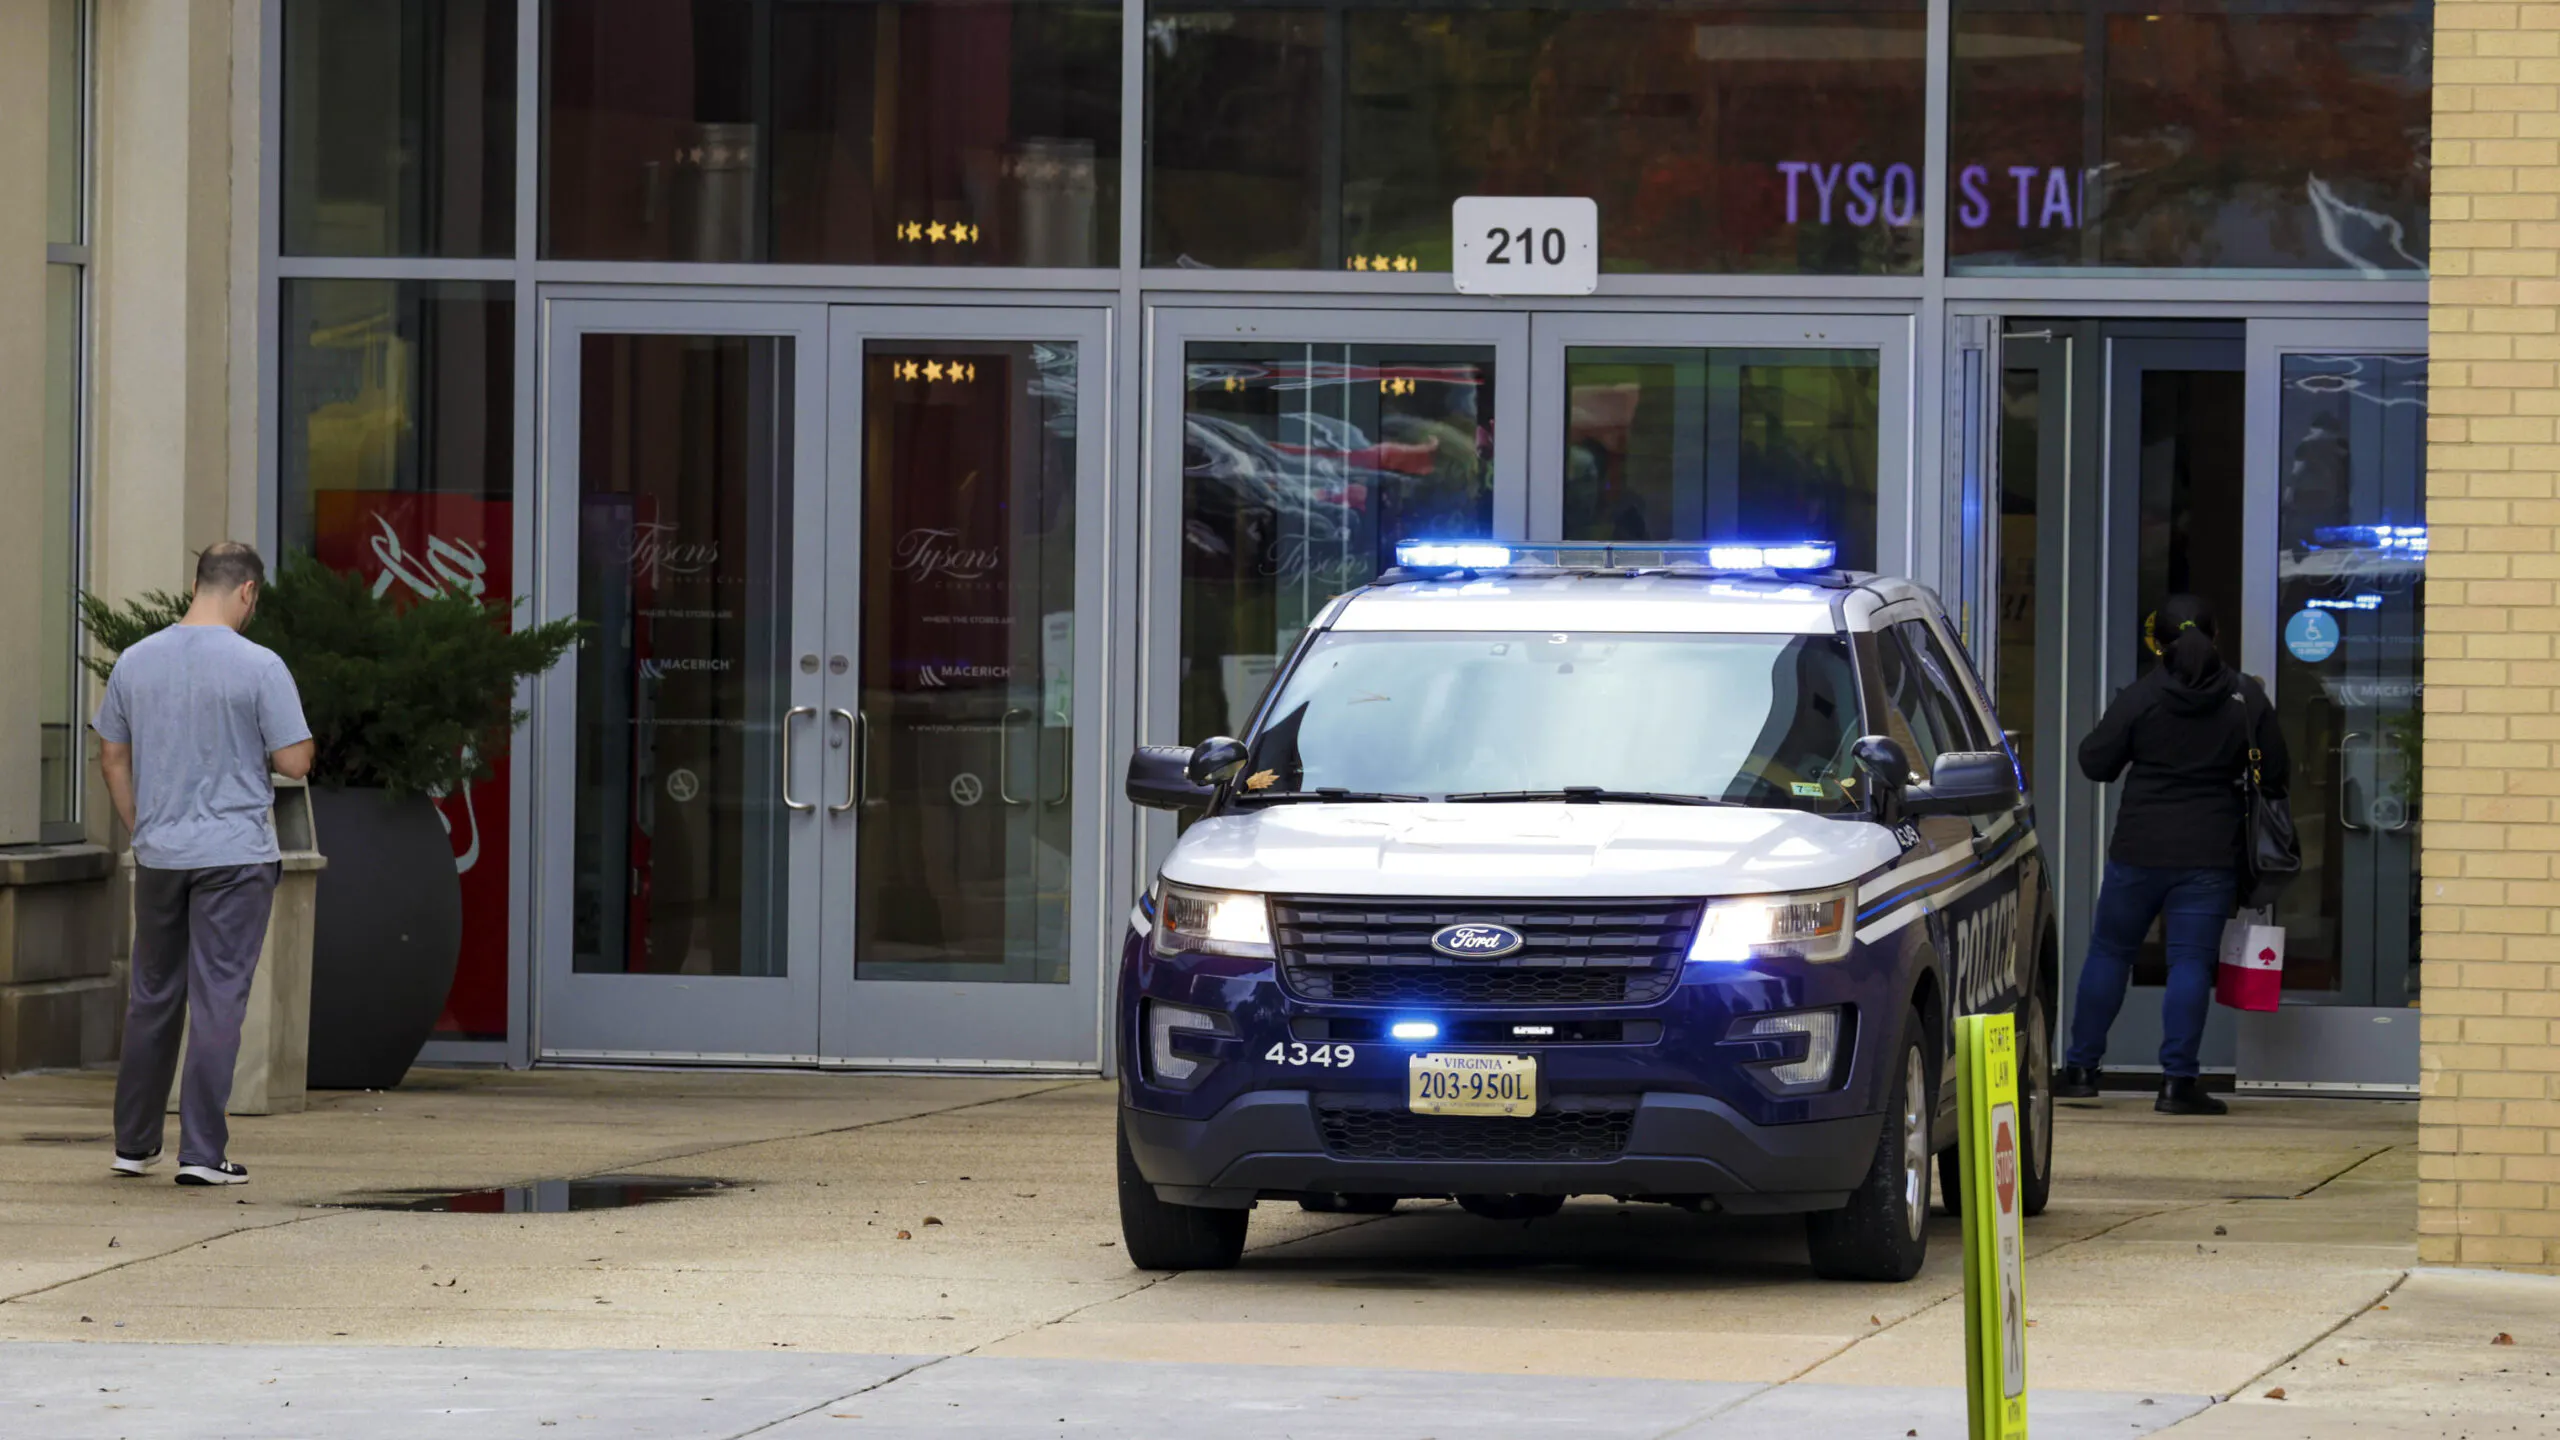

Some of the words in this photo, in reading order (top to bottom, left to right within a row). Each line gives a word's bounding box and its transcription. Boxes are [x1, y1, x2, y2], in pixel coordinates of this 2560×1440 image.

[1777, 161, 1990, 228] TYSOS
[2008, 165, 2083, 228] TA
[1486, 227, 1566, 265] 210
[615, 521, 719, 578] Tysons
[889, 527, 999, 583] Tysons
[1258, 533, 1368, 588] Tysons
[660, 659, 730, 671] MACERICH
[941, 665, 1011, 677] MACERICH
[2361, 685, 2424, 697] MACERIC
[1450, 927, 1501, 948] Ford
[1953, 888, 2017, 1020] POLICE
[1989, 1026, 2010, 1053] STATE
[1265, 1042, 1355, 1068] 4349
[1444, 1058, 1503, 1069] VIRGINIA
[1419, 1072, 1529, 1100] 203-950L
[1997, 1149, 2013, 1185] STOP
